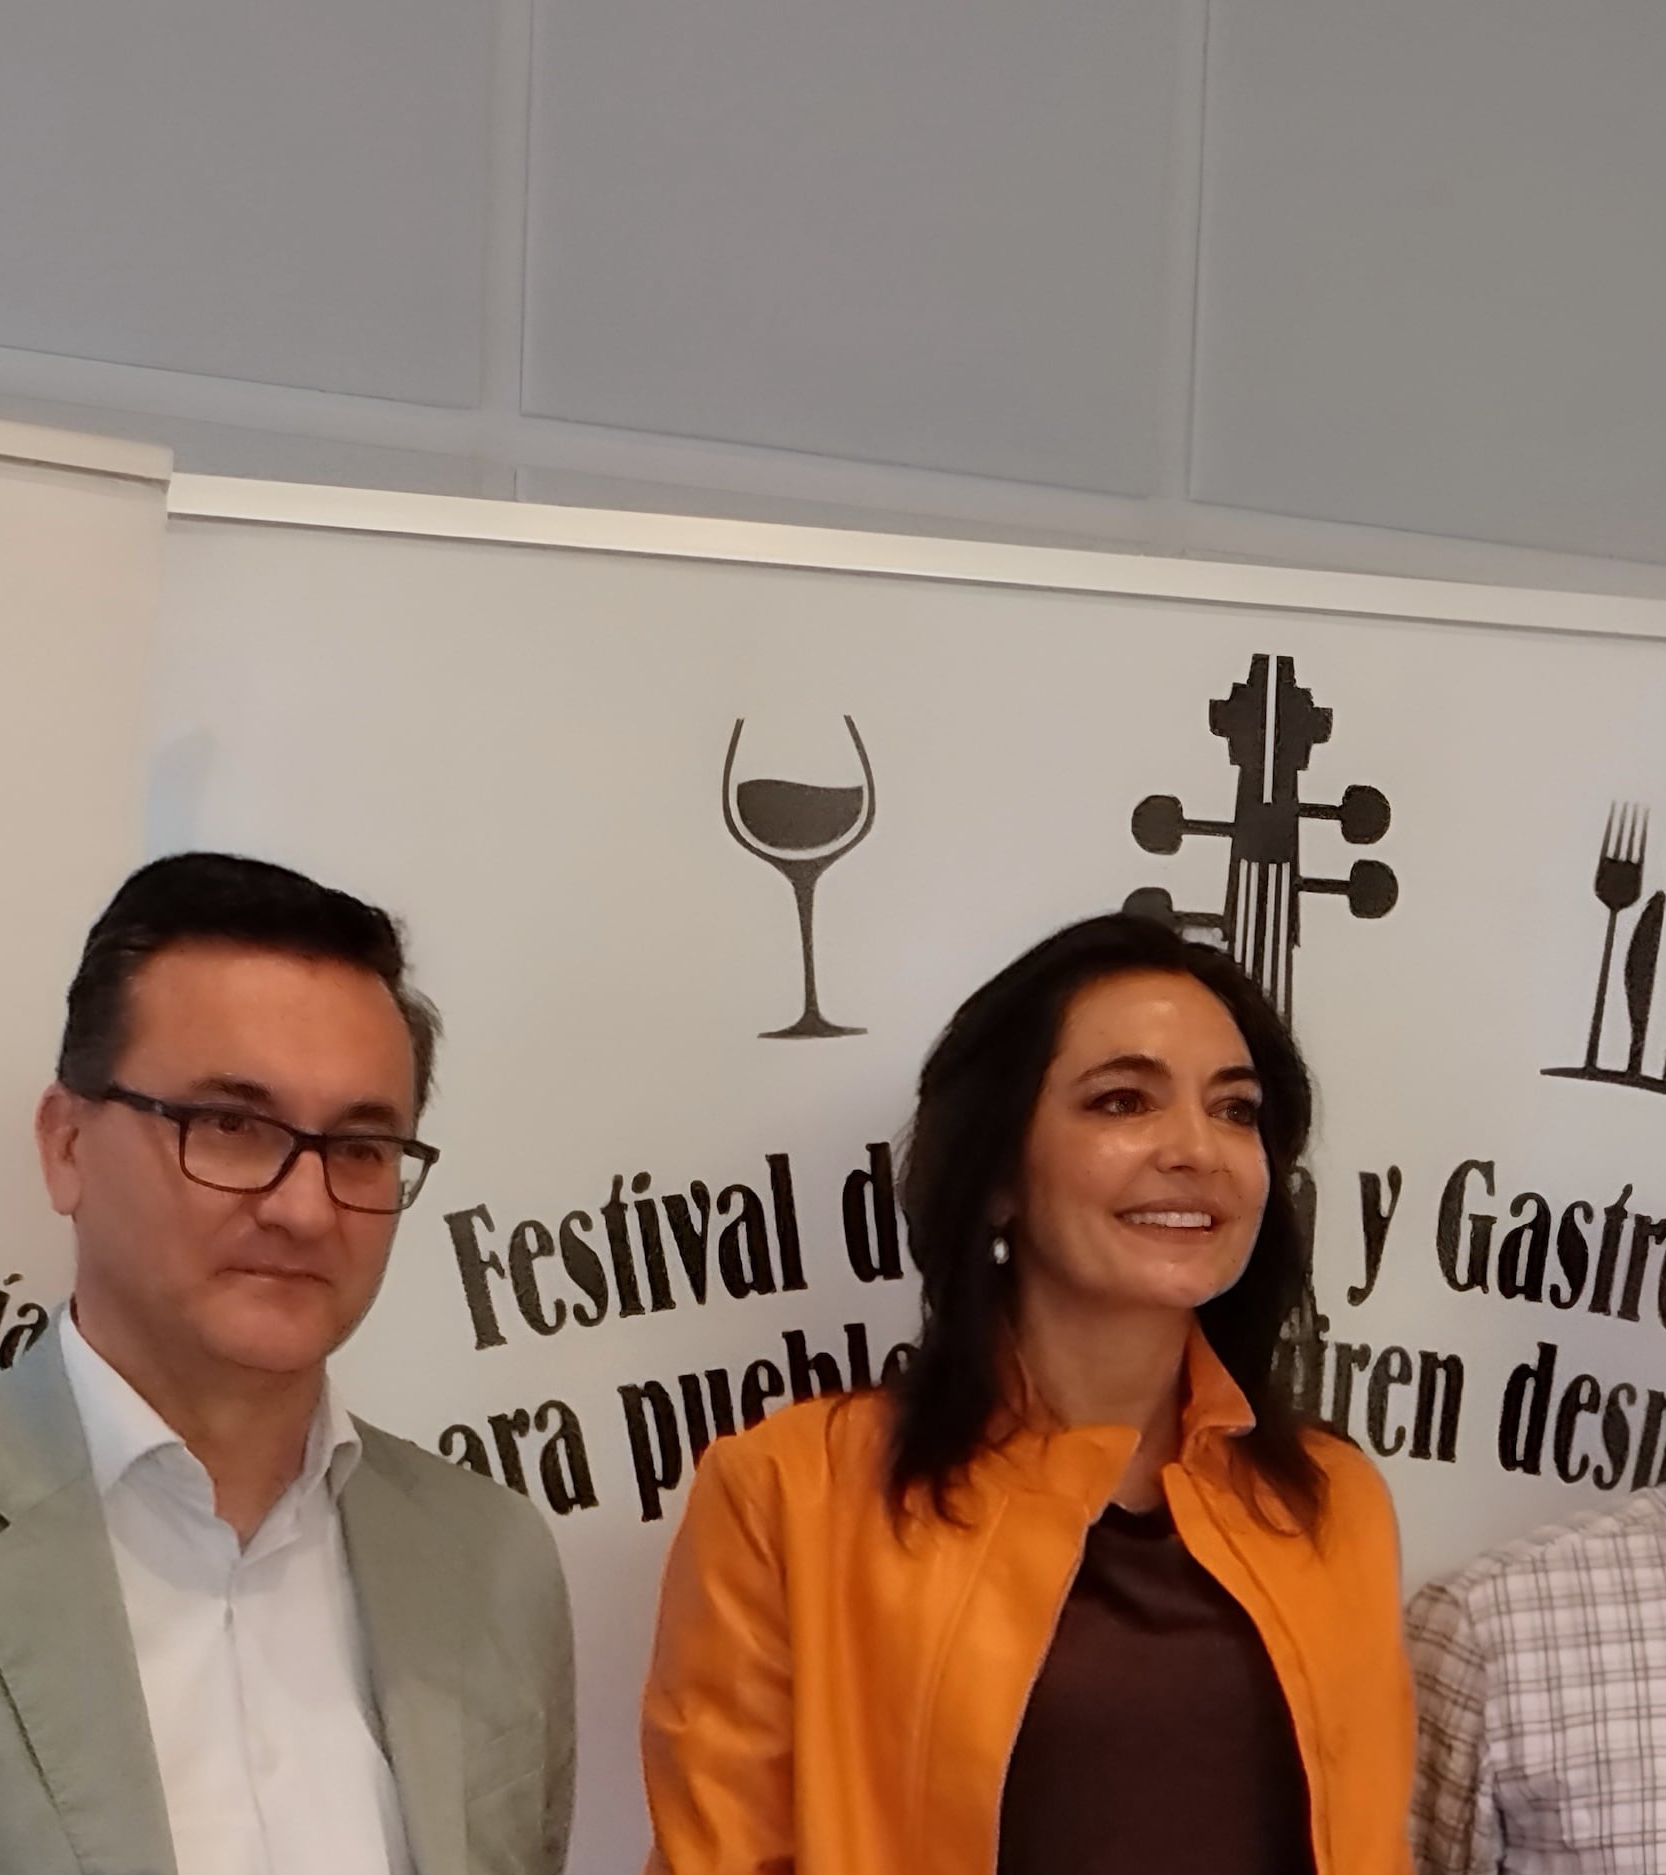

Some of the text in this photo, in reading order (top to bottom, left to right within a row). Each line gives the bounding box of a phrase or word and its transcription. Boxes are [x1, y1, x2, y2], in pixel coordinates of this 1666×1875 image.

[443, 1141, 904, 1351] Festival d
[1347, 1164, 1402, 1307] y
[438, 1398, 600, 1516] ara
